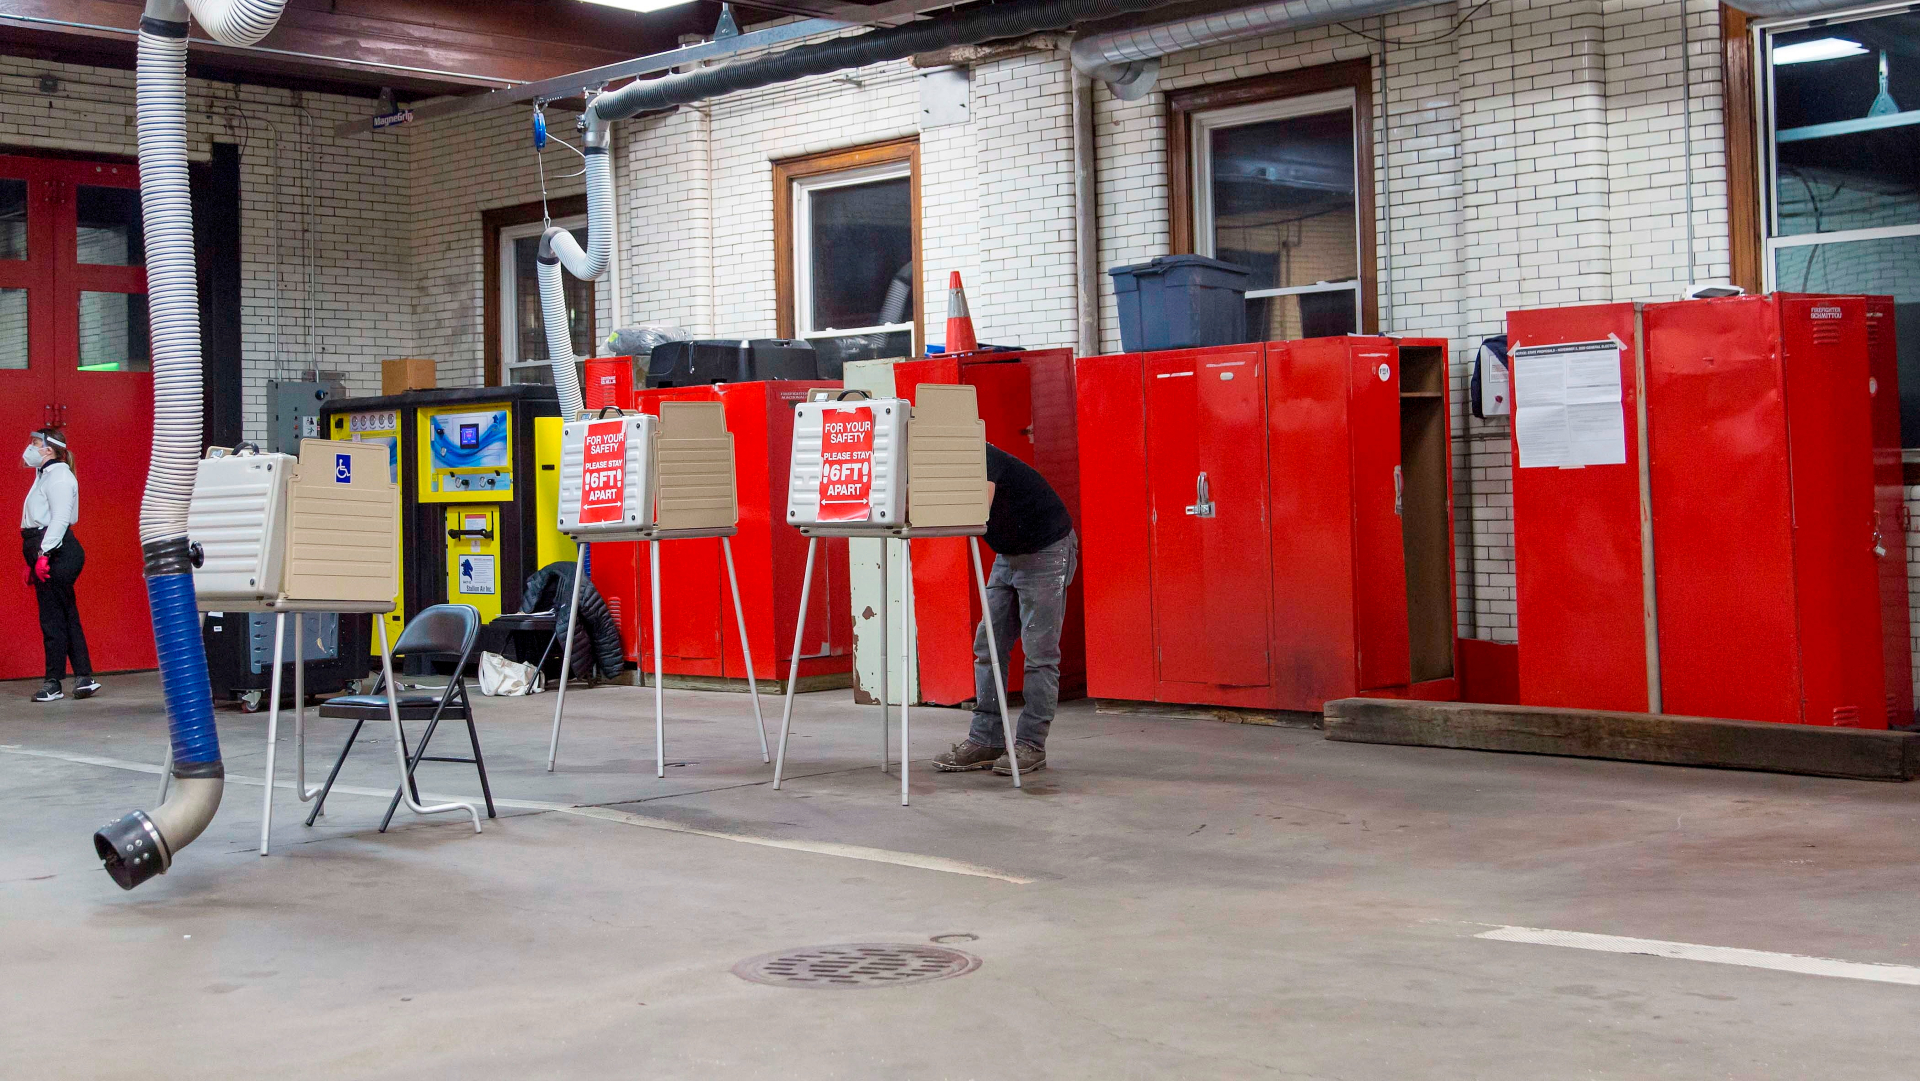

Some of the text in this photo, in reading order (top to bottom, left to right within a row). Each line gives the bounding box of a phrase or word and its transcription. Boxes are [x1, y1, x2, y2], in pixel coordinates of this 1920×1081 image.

[373, 109, 413, 127] MagneGrip
[824, 421, 871, 434] FOR YOUR
[586, 432, 624, 446] FOR YOUR
[830, 432, 865, 444] SAFETY
[591, 443, 619, 454] SAFETY
[823, 451, 870, 461] PLEASE STAY
[585, 459, 623, 470] PLEASE STAY
[589, 489, 617, 501] APART
[827, 483, 862, 496] APART
